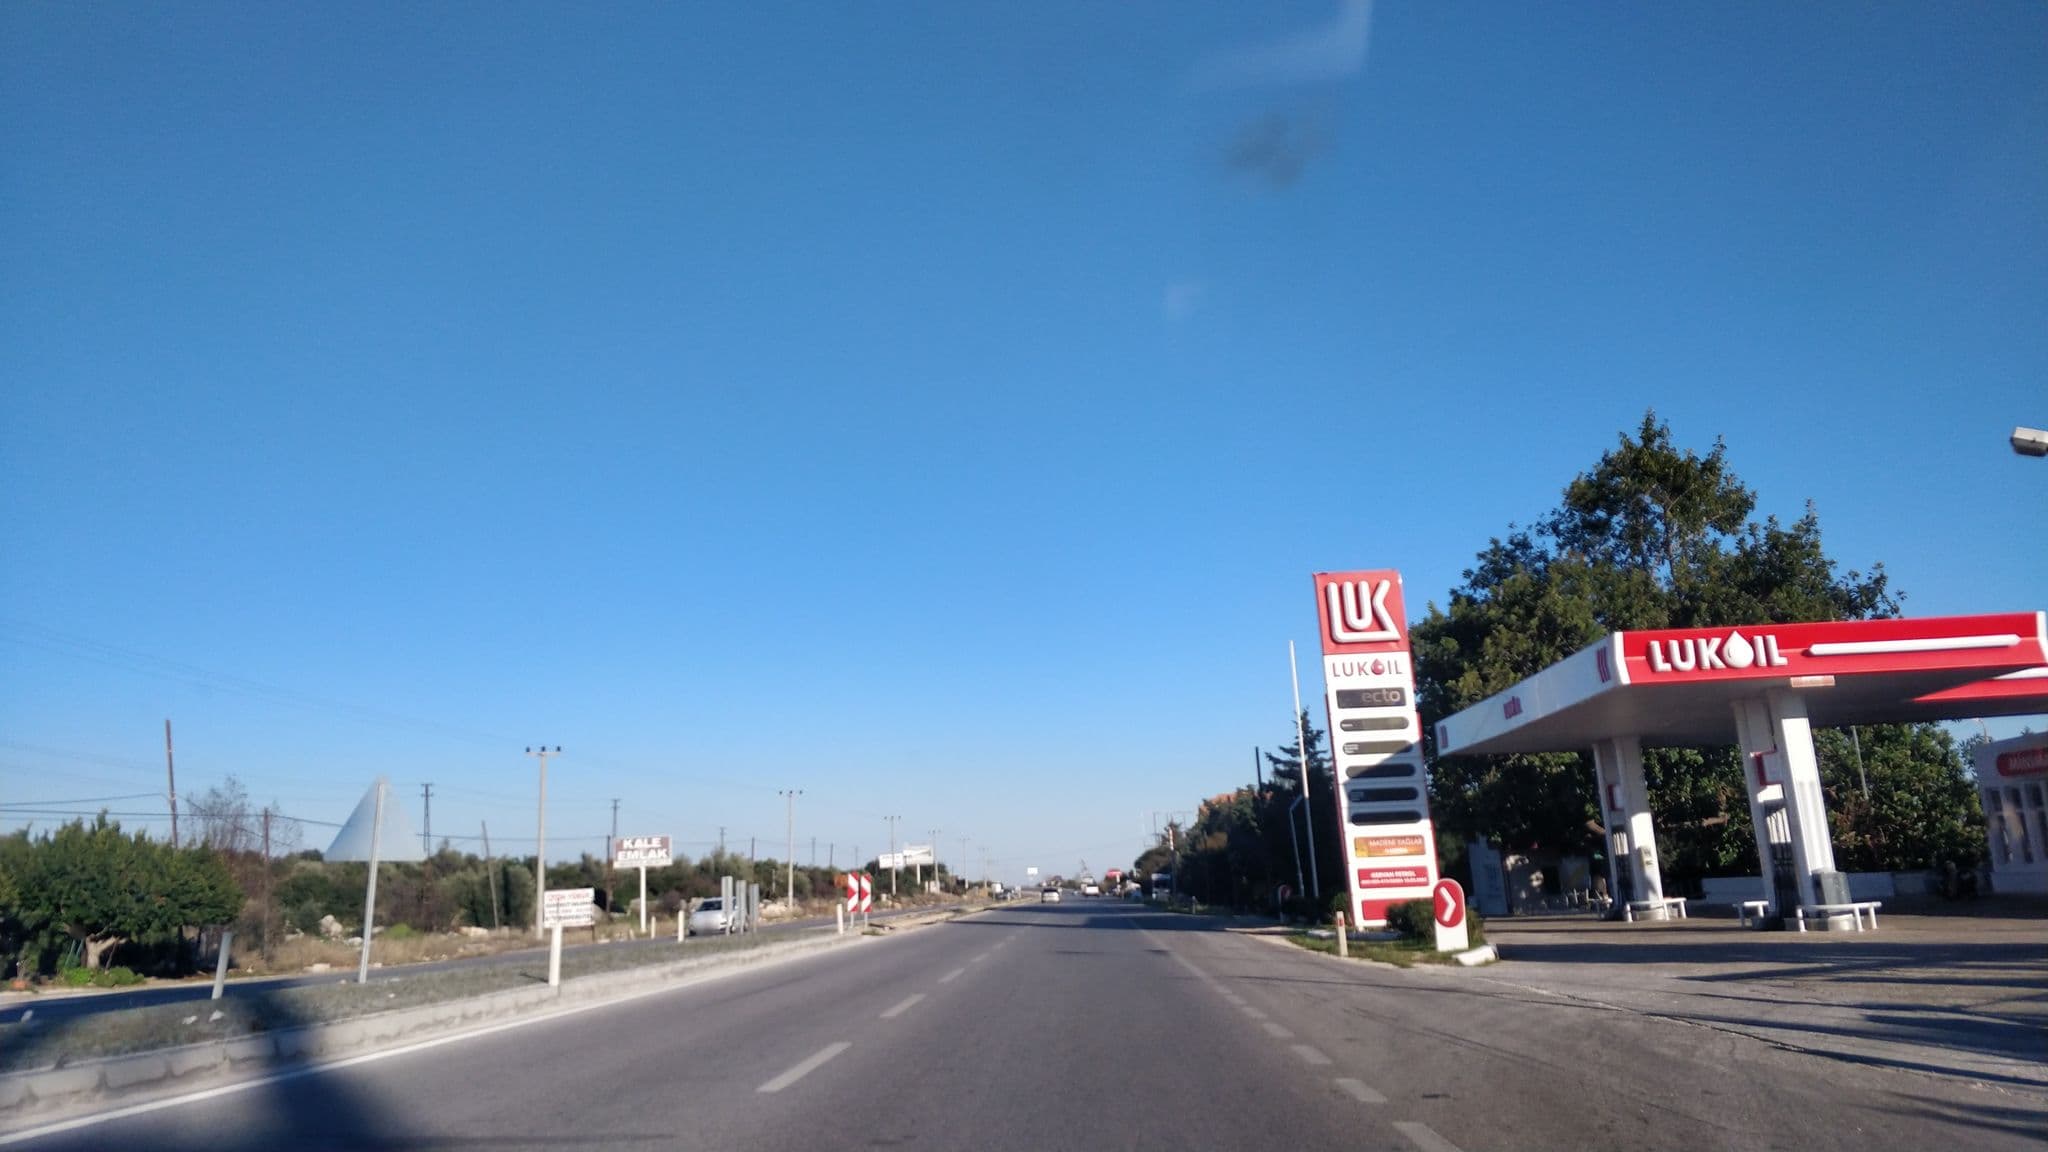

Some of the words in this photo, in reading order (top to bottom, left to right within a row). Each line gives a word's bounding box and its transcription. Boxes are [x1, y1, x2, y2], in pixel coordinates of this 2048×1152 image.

[1327, 580, 1401, 643] LUK
[1649, 630, 1788, 672] LUKOIL
[1332, 658, 1403, 677] LUKOIL
[1362, 688, 1401, 703] ecto
[623, 837, 662, 849] KALE
[617, 848, 669, 860] EMLAK
